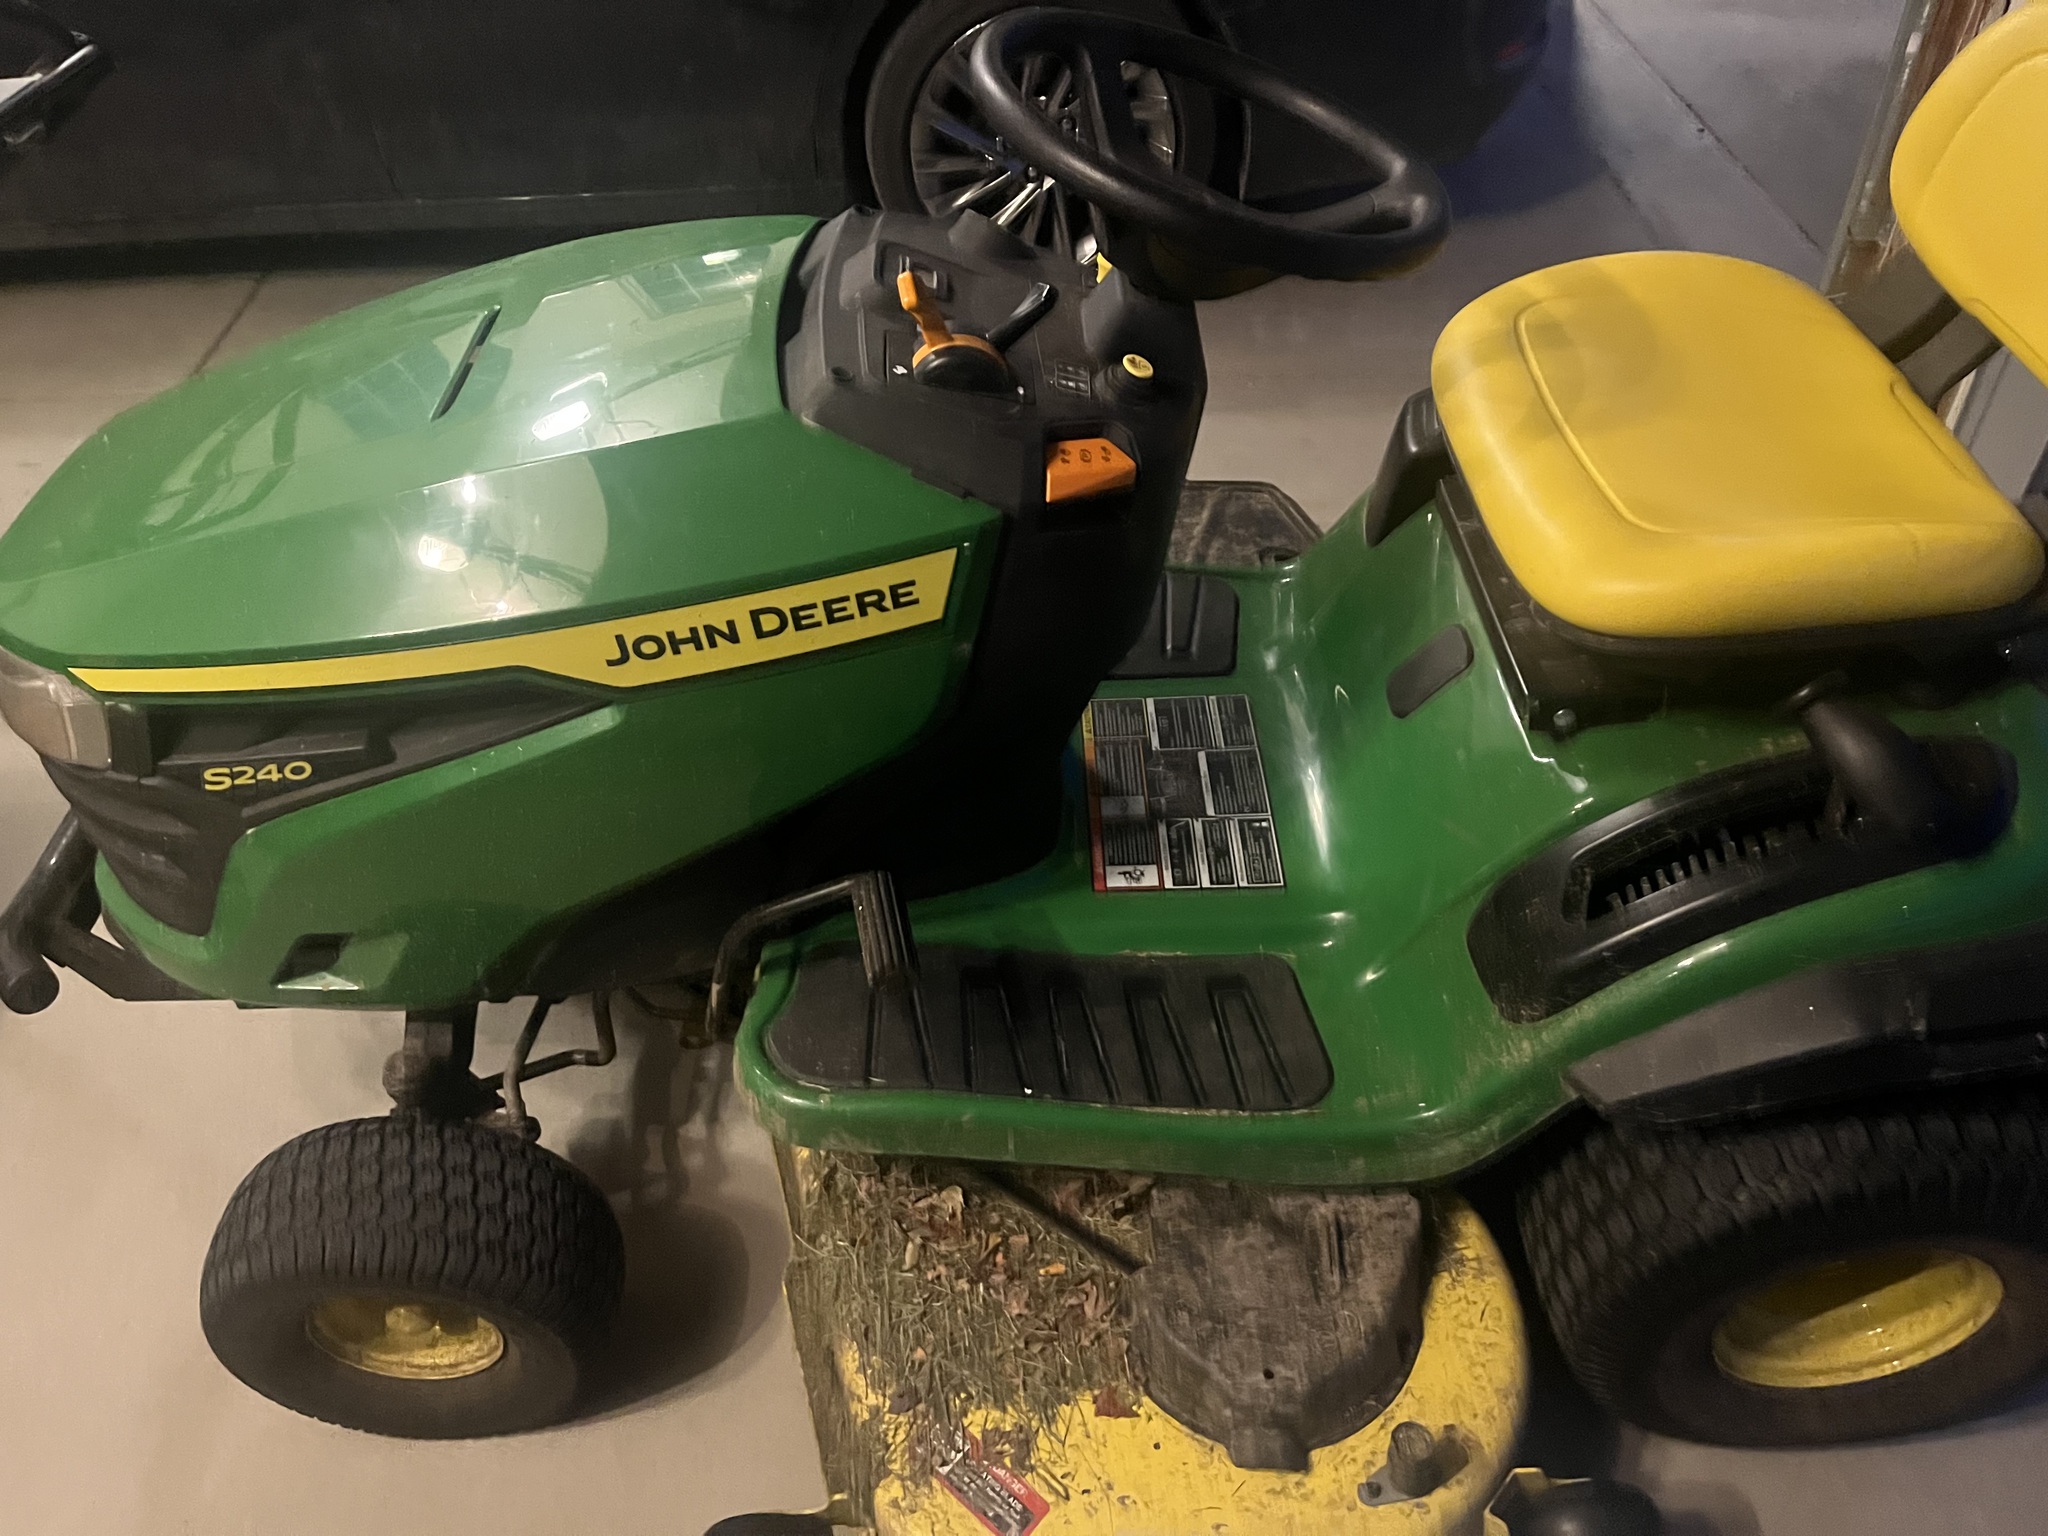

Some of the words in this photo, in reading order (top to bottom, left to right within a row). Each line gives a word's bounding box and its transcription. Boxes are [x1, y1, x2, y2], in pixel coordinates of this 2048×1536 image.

[605, 619, 741, 667] JOHN
[749, 579, 920, 640] DEERE
[203, 760, 313, 791] S240
